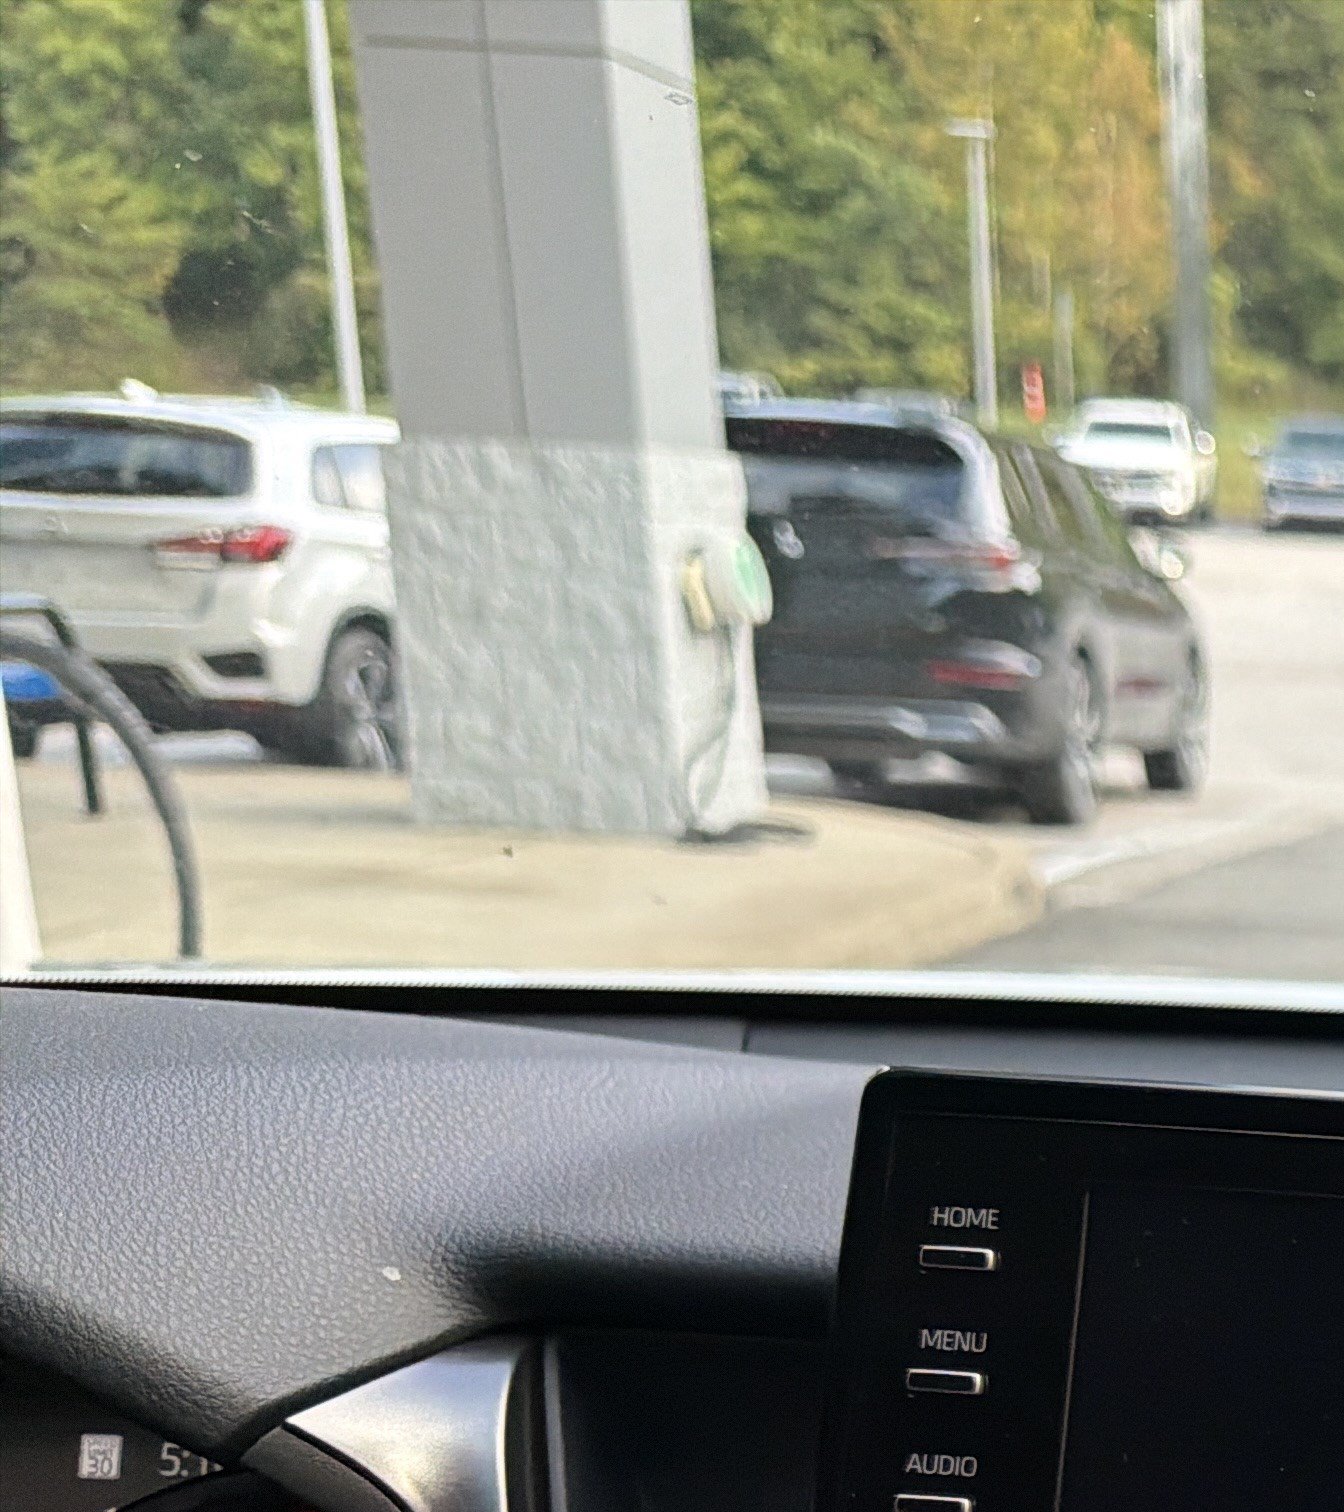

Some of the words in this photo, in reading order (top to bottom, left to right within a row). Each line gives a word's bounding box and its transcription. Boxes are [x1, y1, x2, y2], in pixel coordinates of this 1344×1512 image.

[931, 1206, 999, 1230] HOME
[920, 1329, 988, 1354] MENU
[905, 1453, 978, 1478] AUDIO
